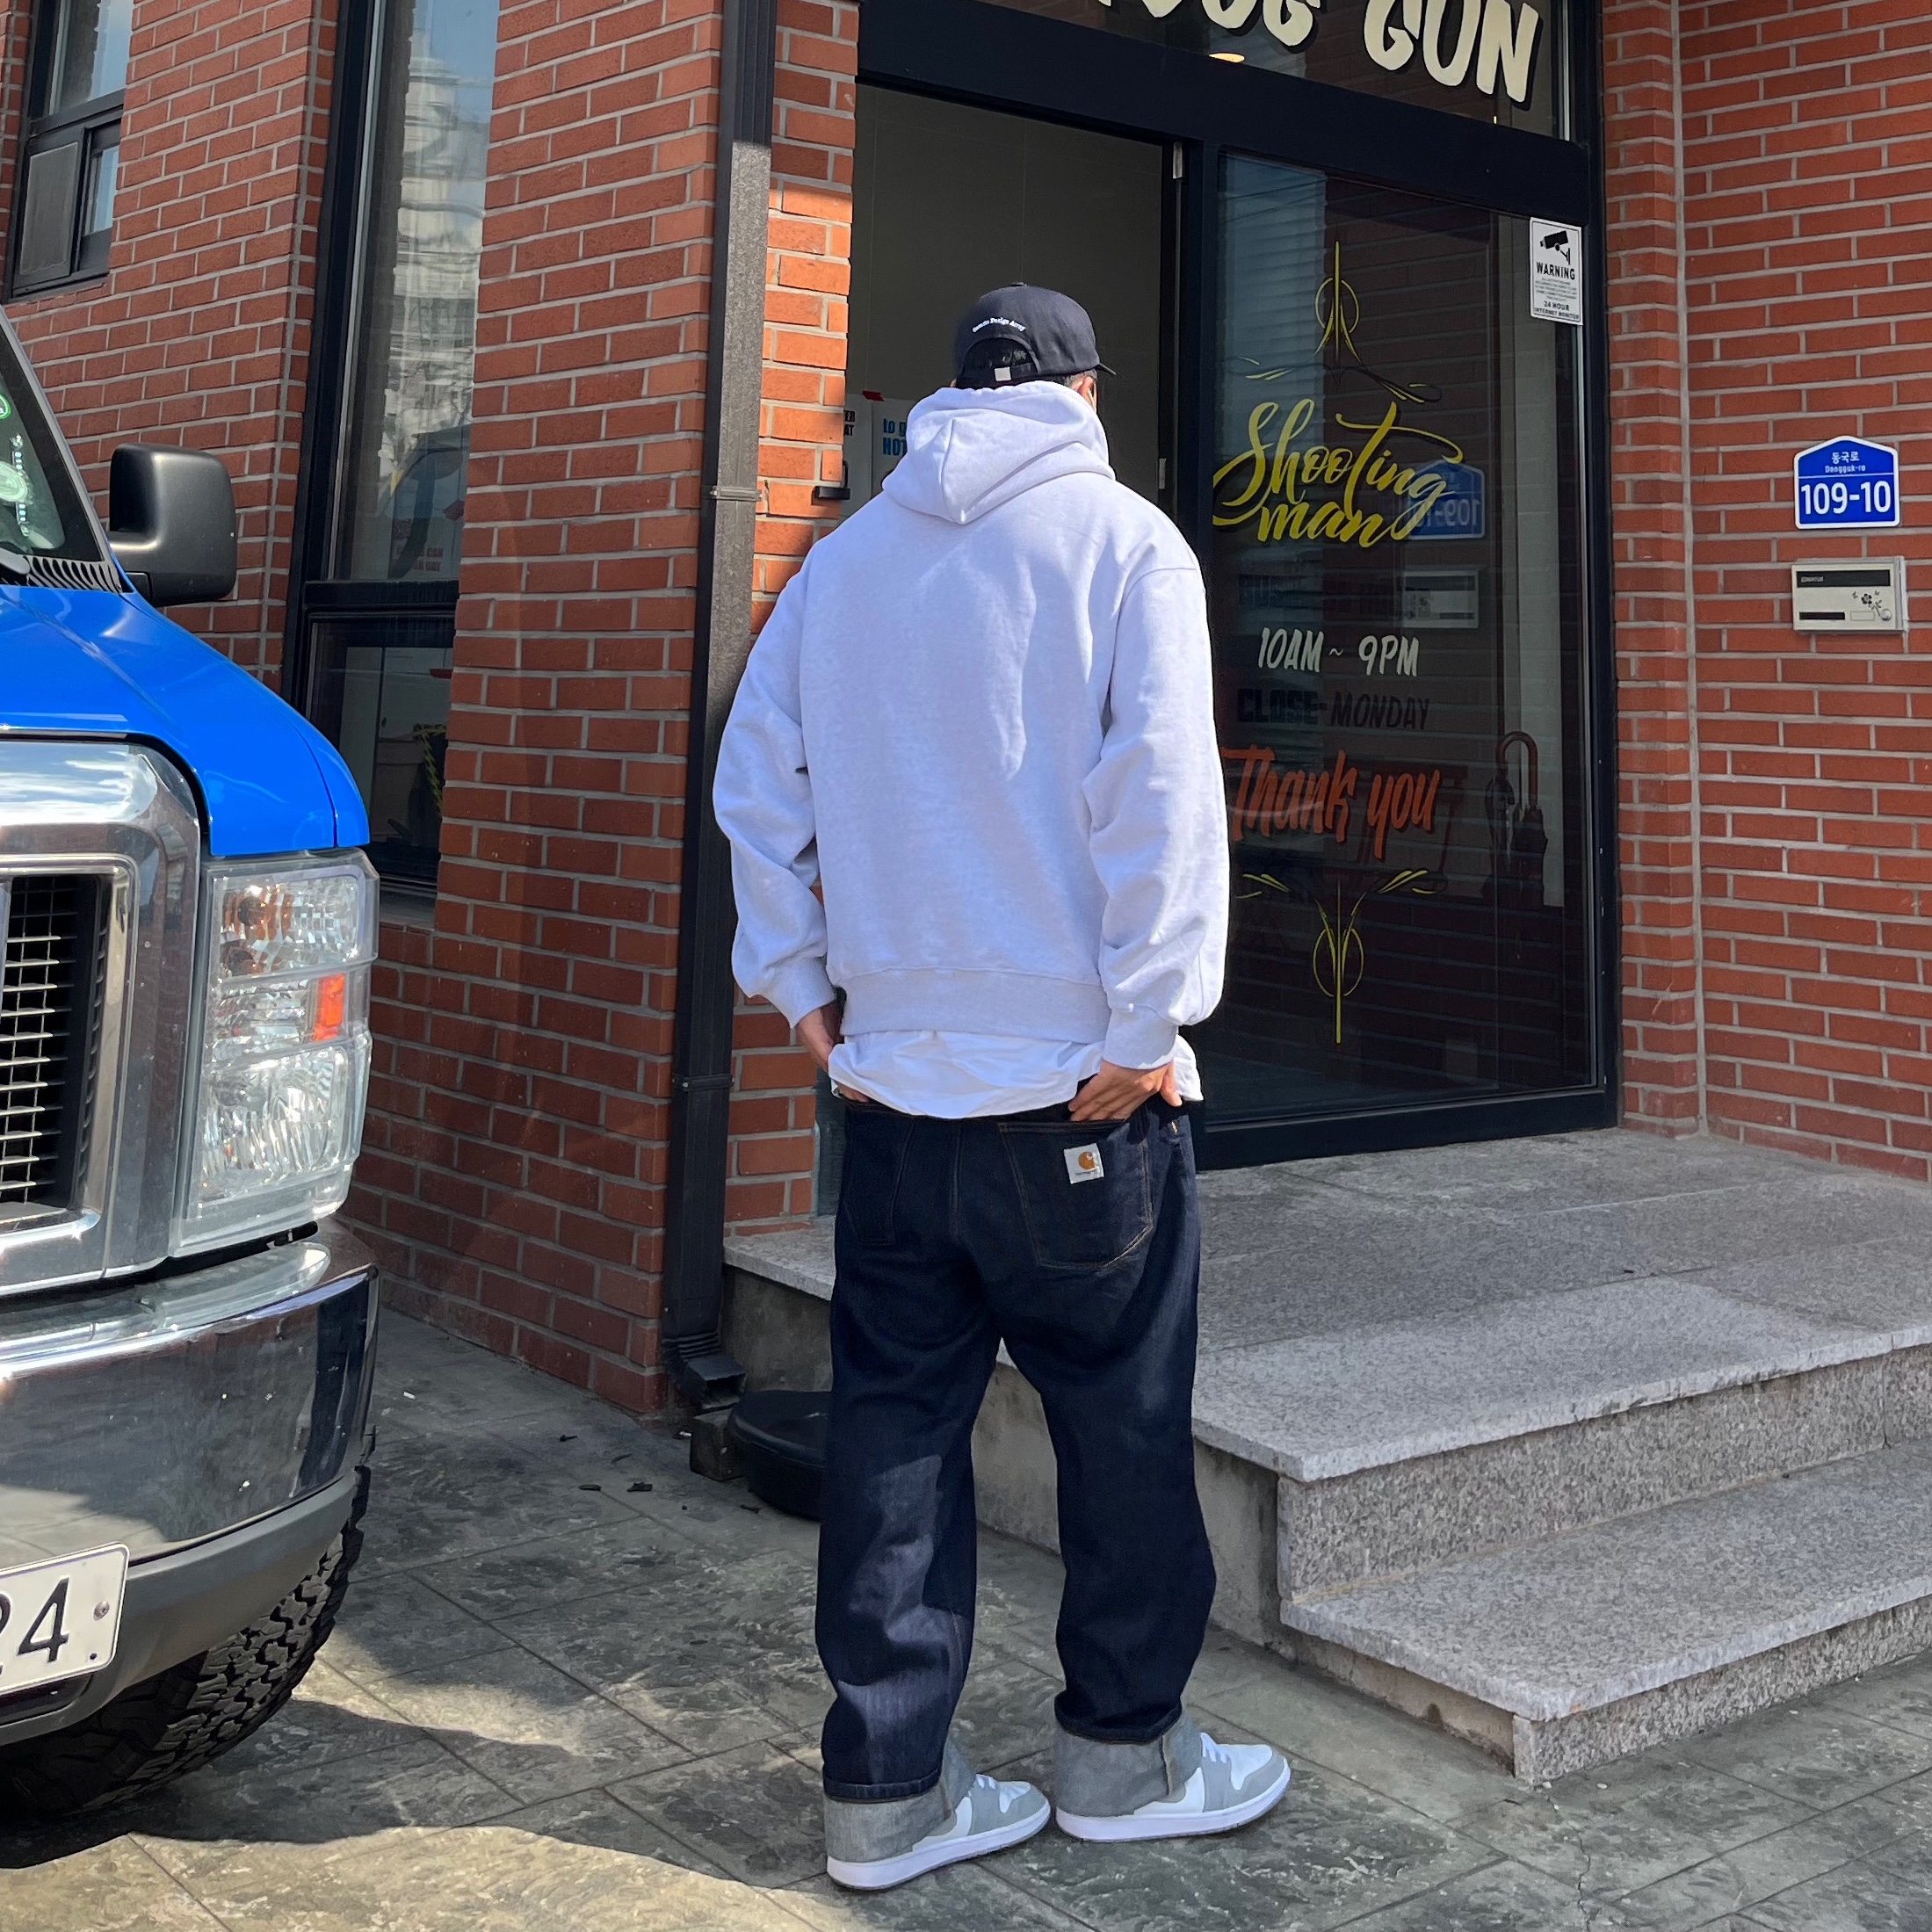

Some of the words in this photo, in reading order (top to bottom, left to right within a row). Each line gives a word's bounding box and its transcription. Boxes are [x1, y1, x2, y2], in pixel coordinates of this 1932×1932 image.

[1364, 0, 1539, 103] GUN
[1536, 262, 1575, 280] WARNING
[1212, 398, 1463, 540] Shooting
[1824, 464, 1866, 474] Dongguk-ro
[1831, 451, 1860, 465] 동국로
[1800, 481, 1892, 515] 109-10
[1257, 501, 1385, 548] man
[1257, 626, 1324, 674] 10AM
[1357, 634, 1420, 677] 9PM
[1219, 745, 1358, 844] Thank
[1367, 769, 1441, 860] you
[0, 1575, 69, 1675] 4
